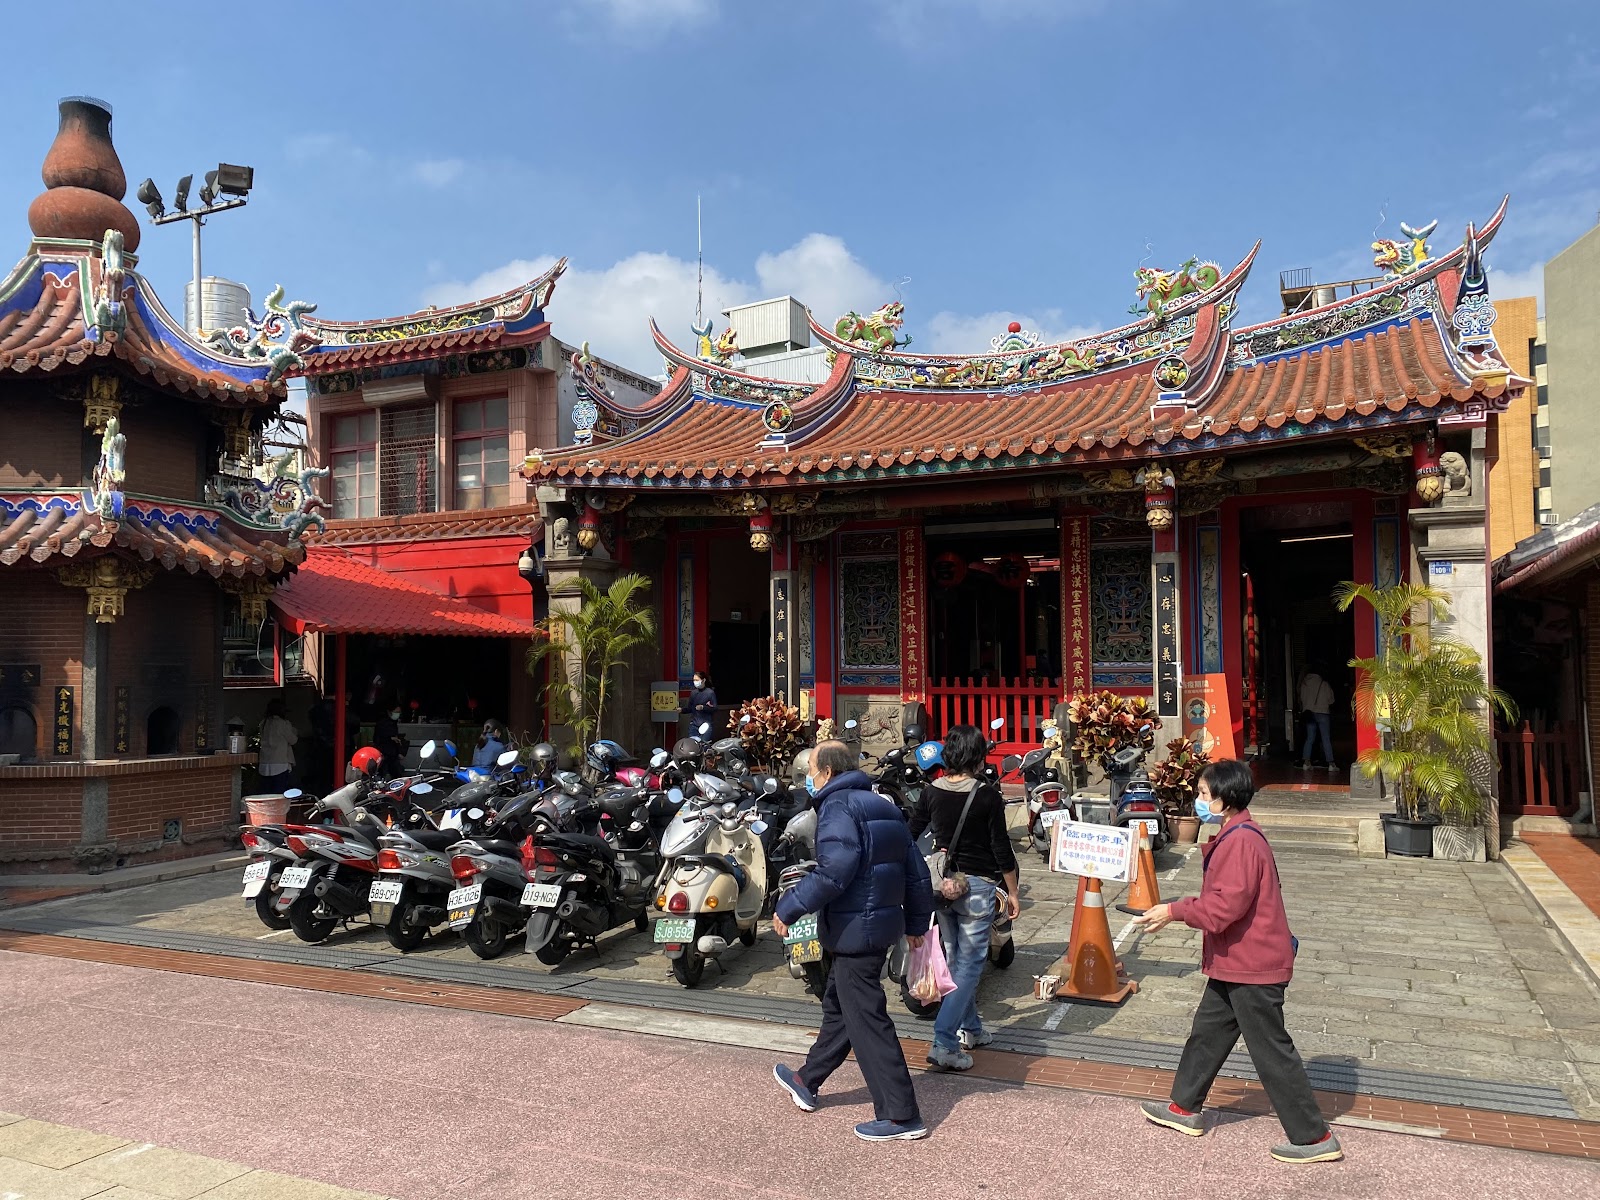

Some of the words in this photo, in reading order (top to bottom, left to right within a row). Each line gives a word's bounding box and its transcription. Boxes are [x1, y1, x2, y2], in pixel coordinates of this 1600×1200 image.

[1159, 574, 1173, 704] 心存忠義二字
[1066, 829, 1124, 845] 臨時停車
[370, 888, 399, 901] 589-CPY
[655, 926, 693, 939] SJ8-592
